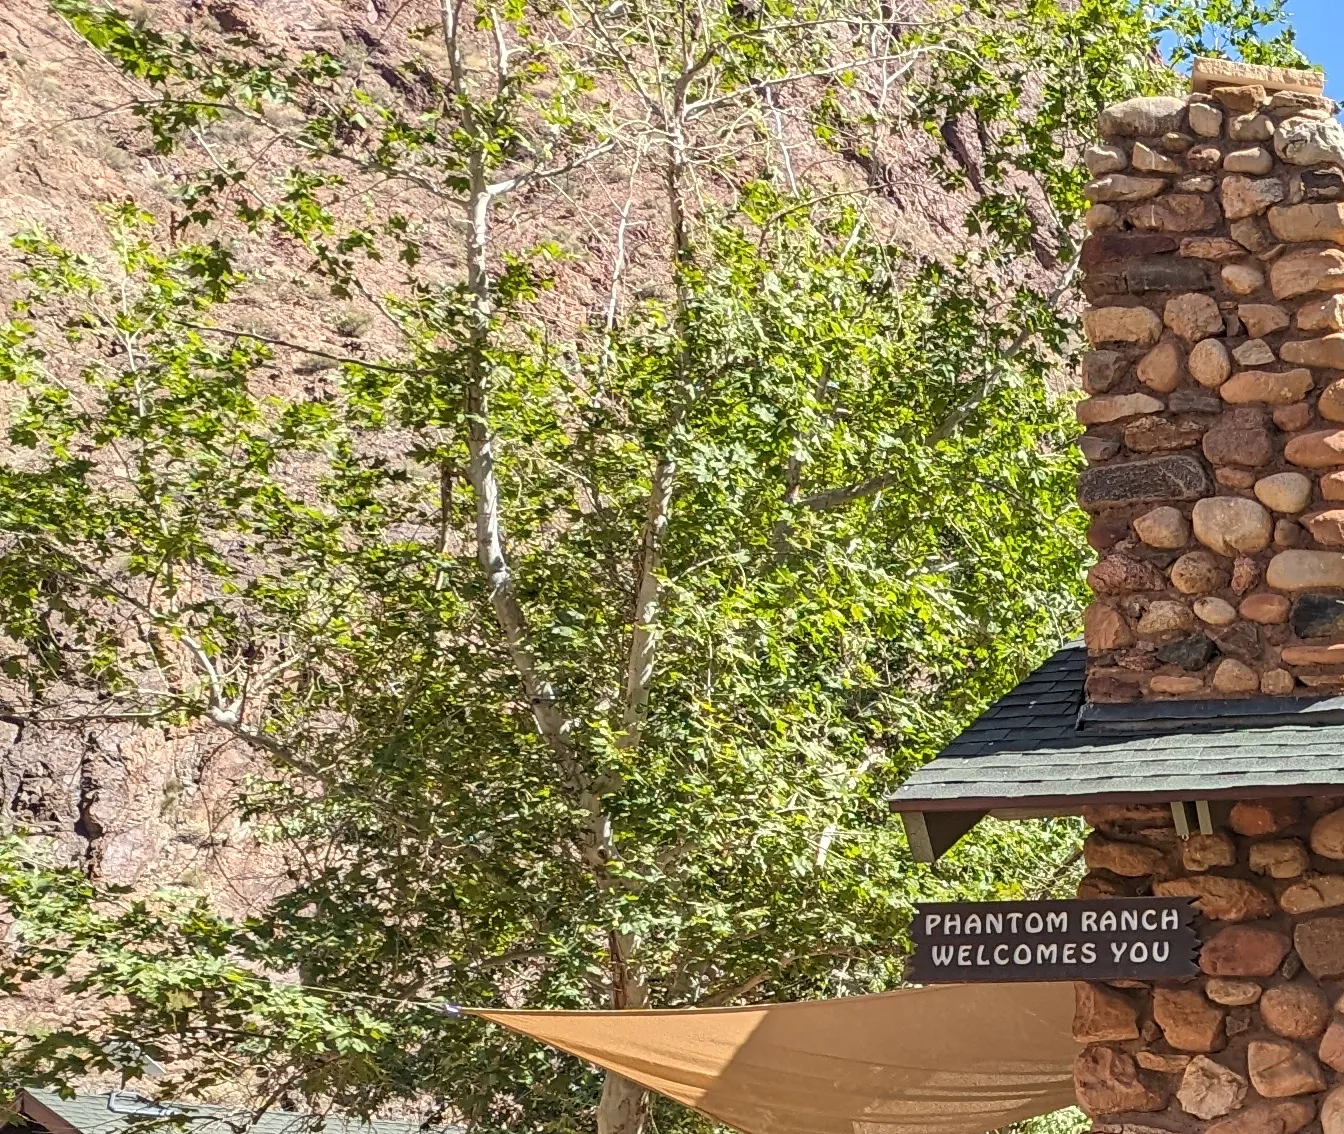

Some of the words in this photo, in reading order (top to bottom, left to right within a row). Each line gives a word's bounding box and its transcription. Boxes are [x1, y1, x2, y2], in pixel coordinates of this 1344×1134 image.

[924, 911, 1069, 936] PHANTOM
[1081, 908, 1179, 932] RANCH
[931, 942, 1097, 967] WELCOMES
[1111, 941, 1170, 964] YOU
